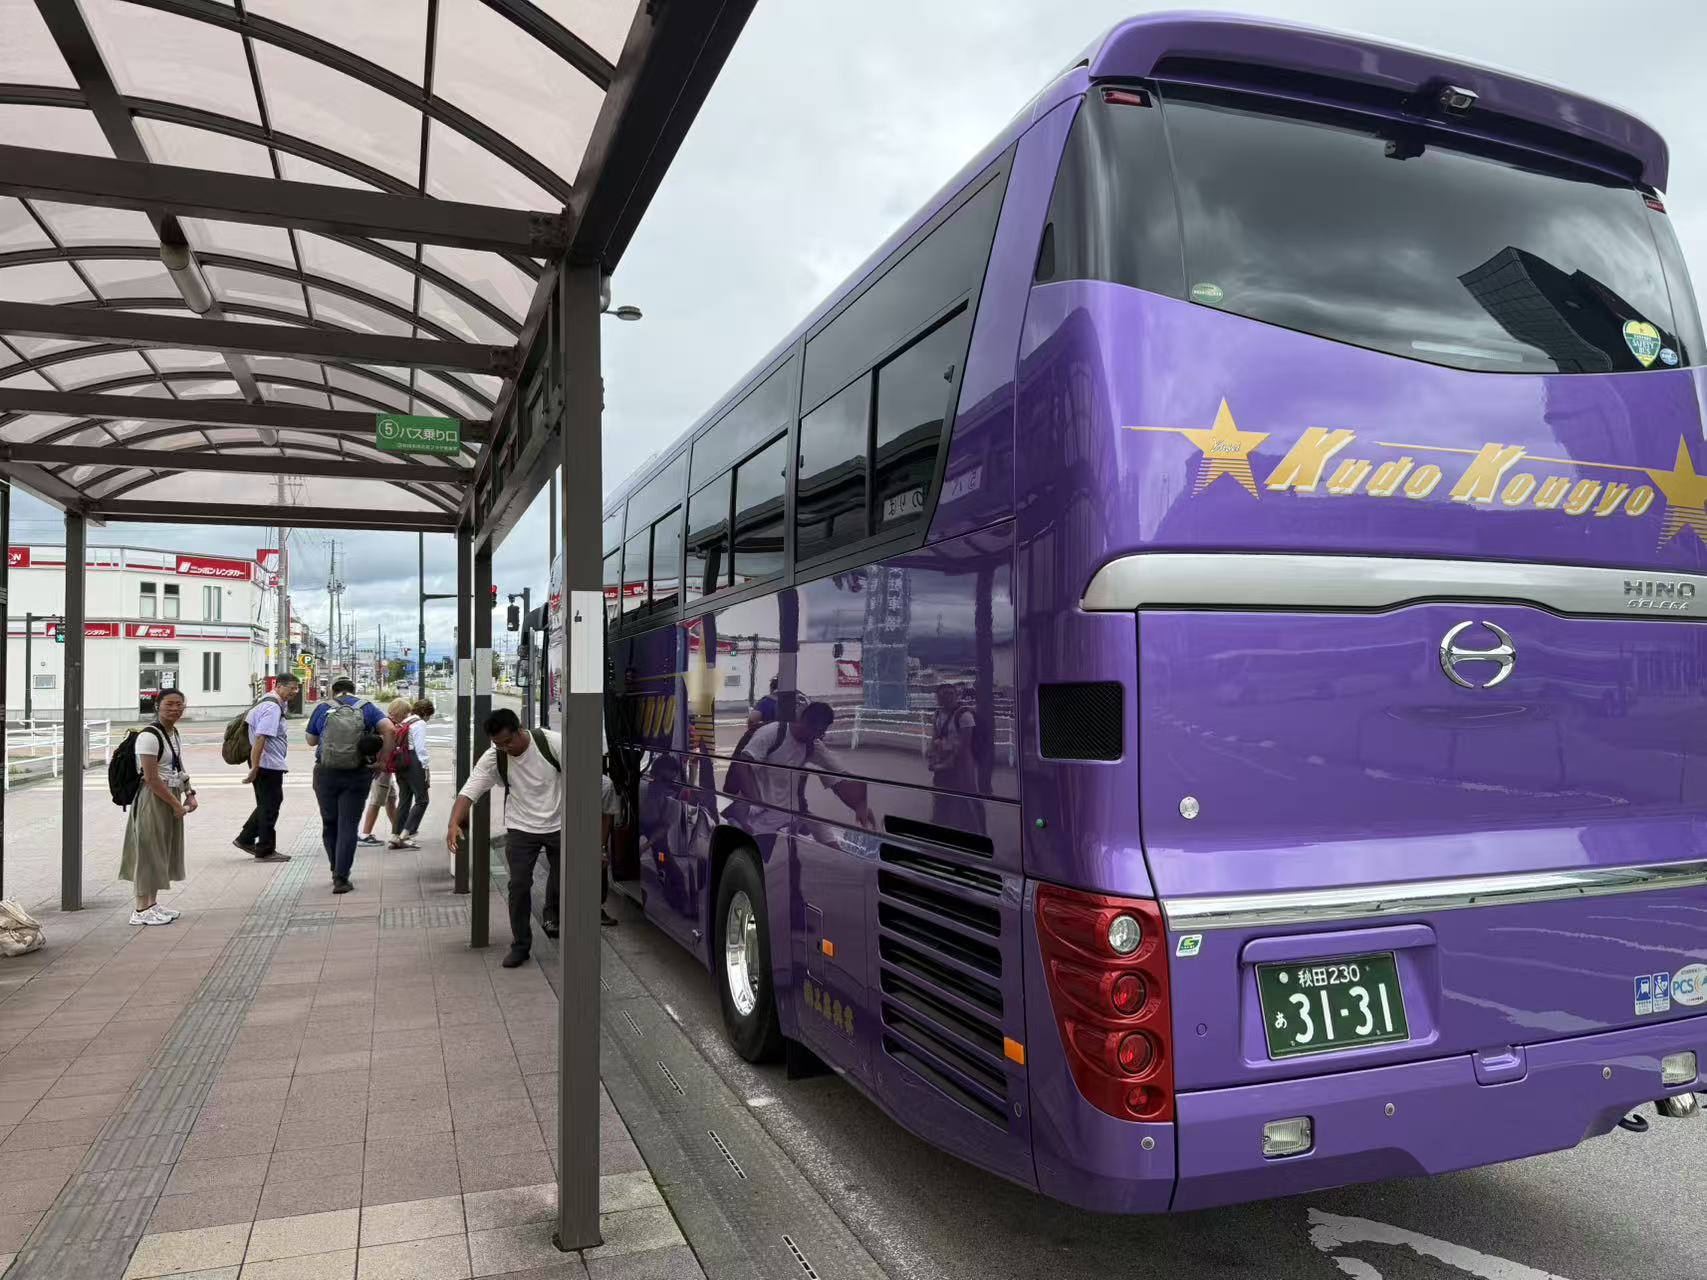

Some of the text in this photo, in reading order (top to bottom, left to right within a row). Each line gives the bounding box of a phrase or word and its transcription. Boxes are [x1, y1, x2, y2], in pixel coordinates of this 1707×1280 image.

[400, 427, 458, 442] バス乗り口
[1264, 427, 1655, 517] Kudo Kougyo
[1623, 579, 1696, 600] HINO
[1274, 982, 1394, 1044] あ 31-31
